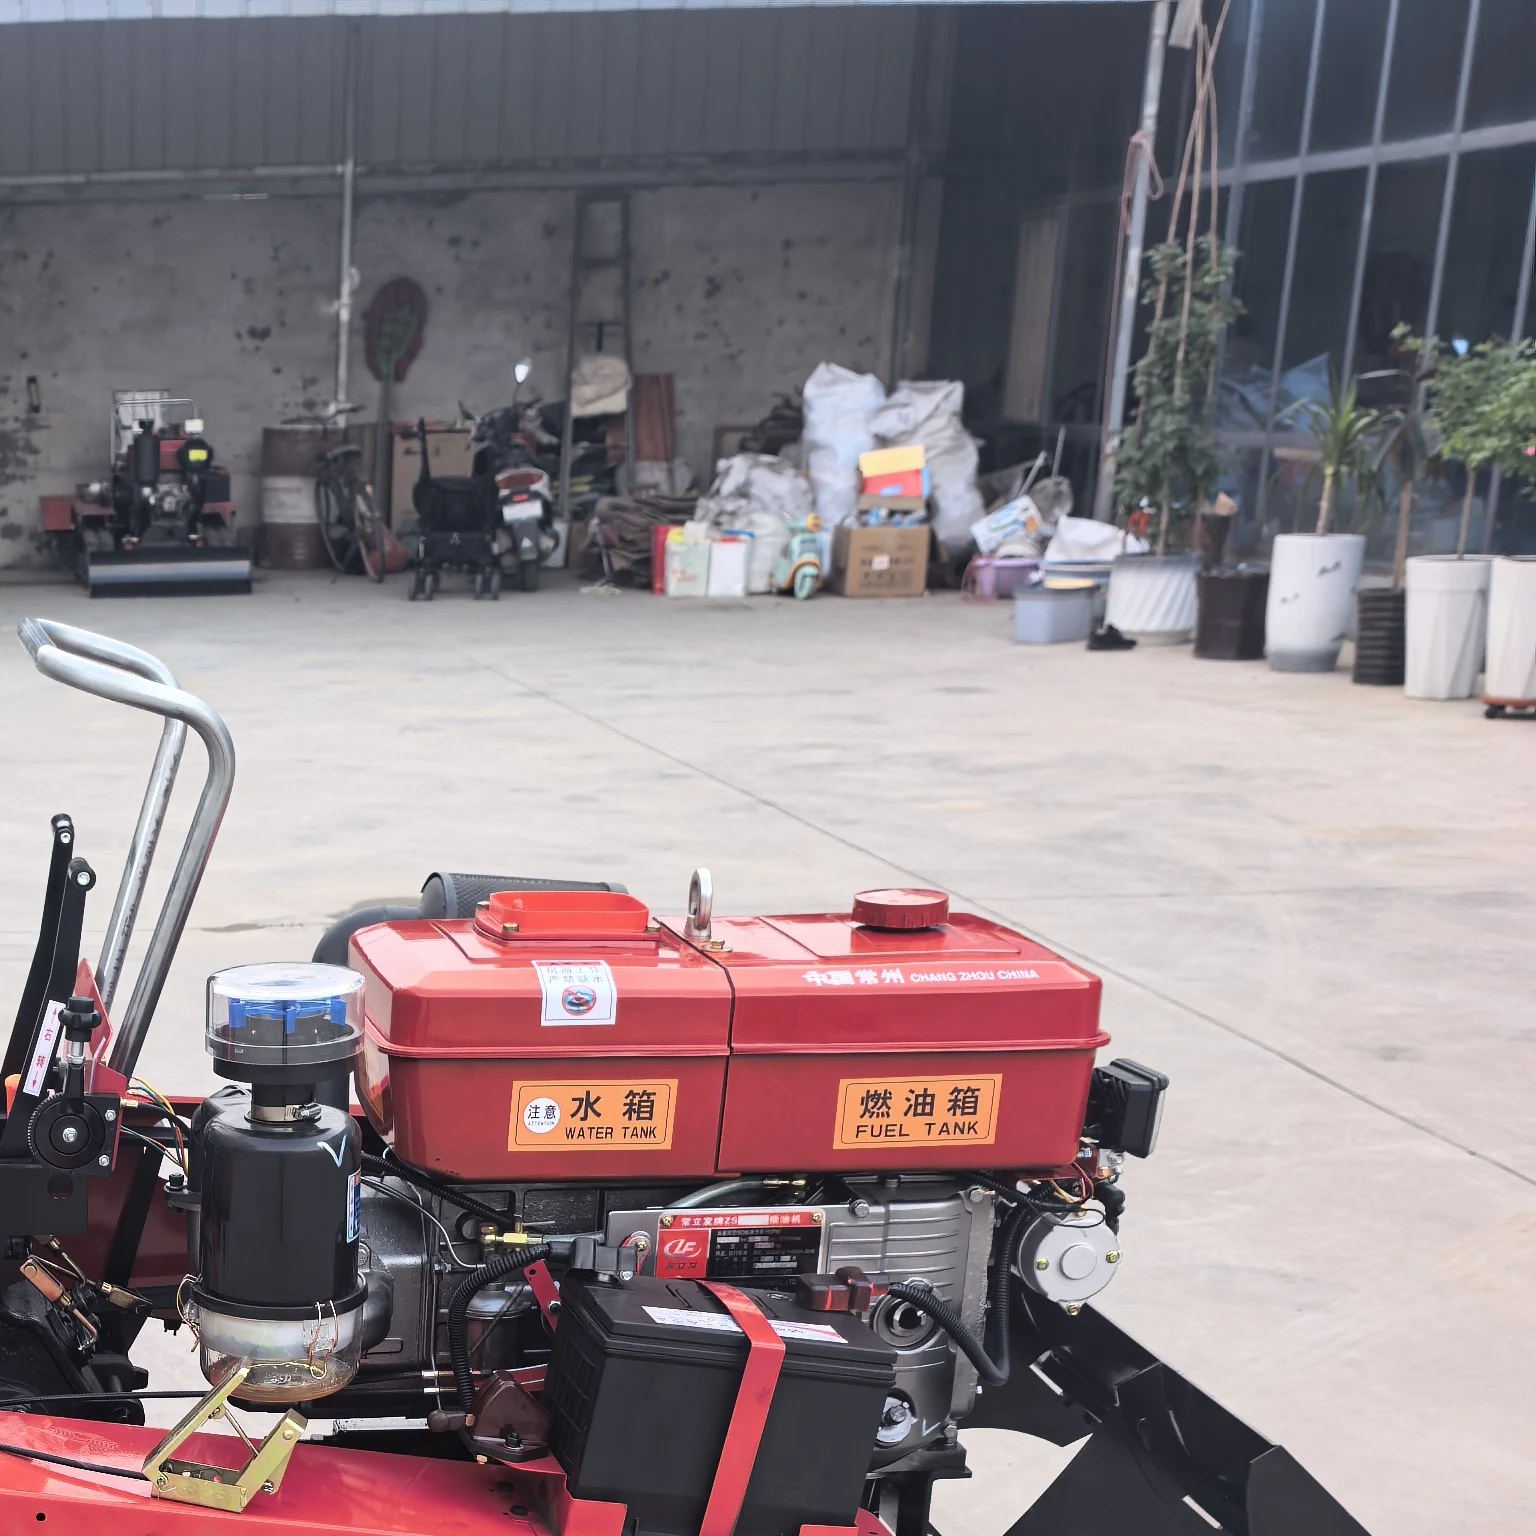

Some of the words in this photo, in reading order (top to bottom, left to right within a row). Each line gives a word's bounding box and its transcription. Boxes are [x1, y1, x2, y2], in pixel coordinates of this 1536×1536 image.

[910, 972, 956, 983] CHANG
[959, 971, 995, 982] ZHOU
[997, 969, 1040, 980] CHINA
[569, 1089, 657, 1122] 水箱
[859, 1086, 981, 1119] 燃油箱
[527, 1104, 557, 1120] 注意
[565, 1126, 614, 1140] WATER
[622, 1126, 657, 1139] TANK
[855, 1123, 910, 1139] FUEL
[924, 1121, 979, 1136] TANK
